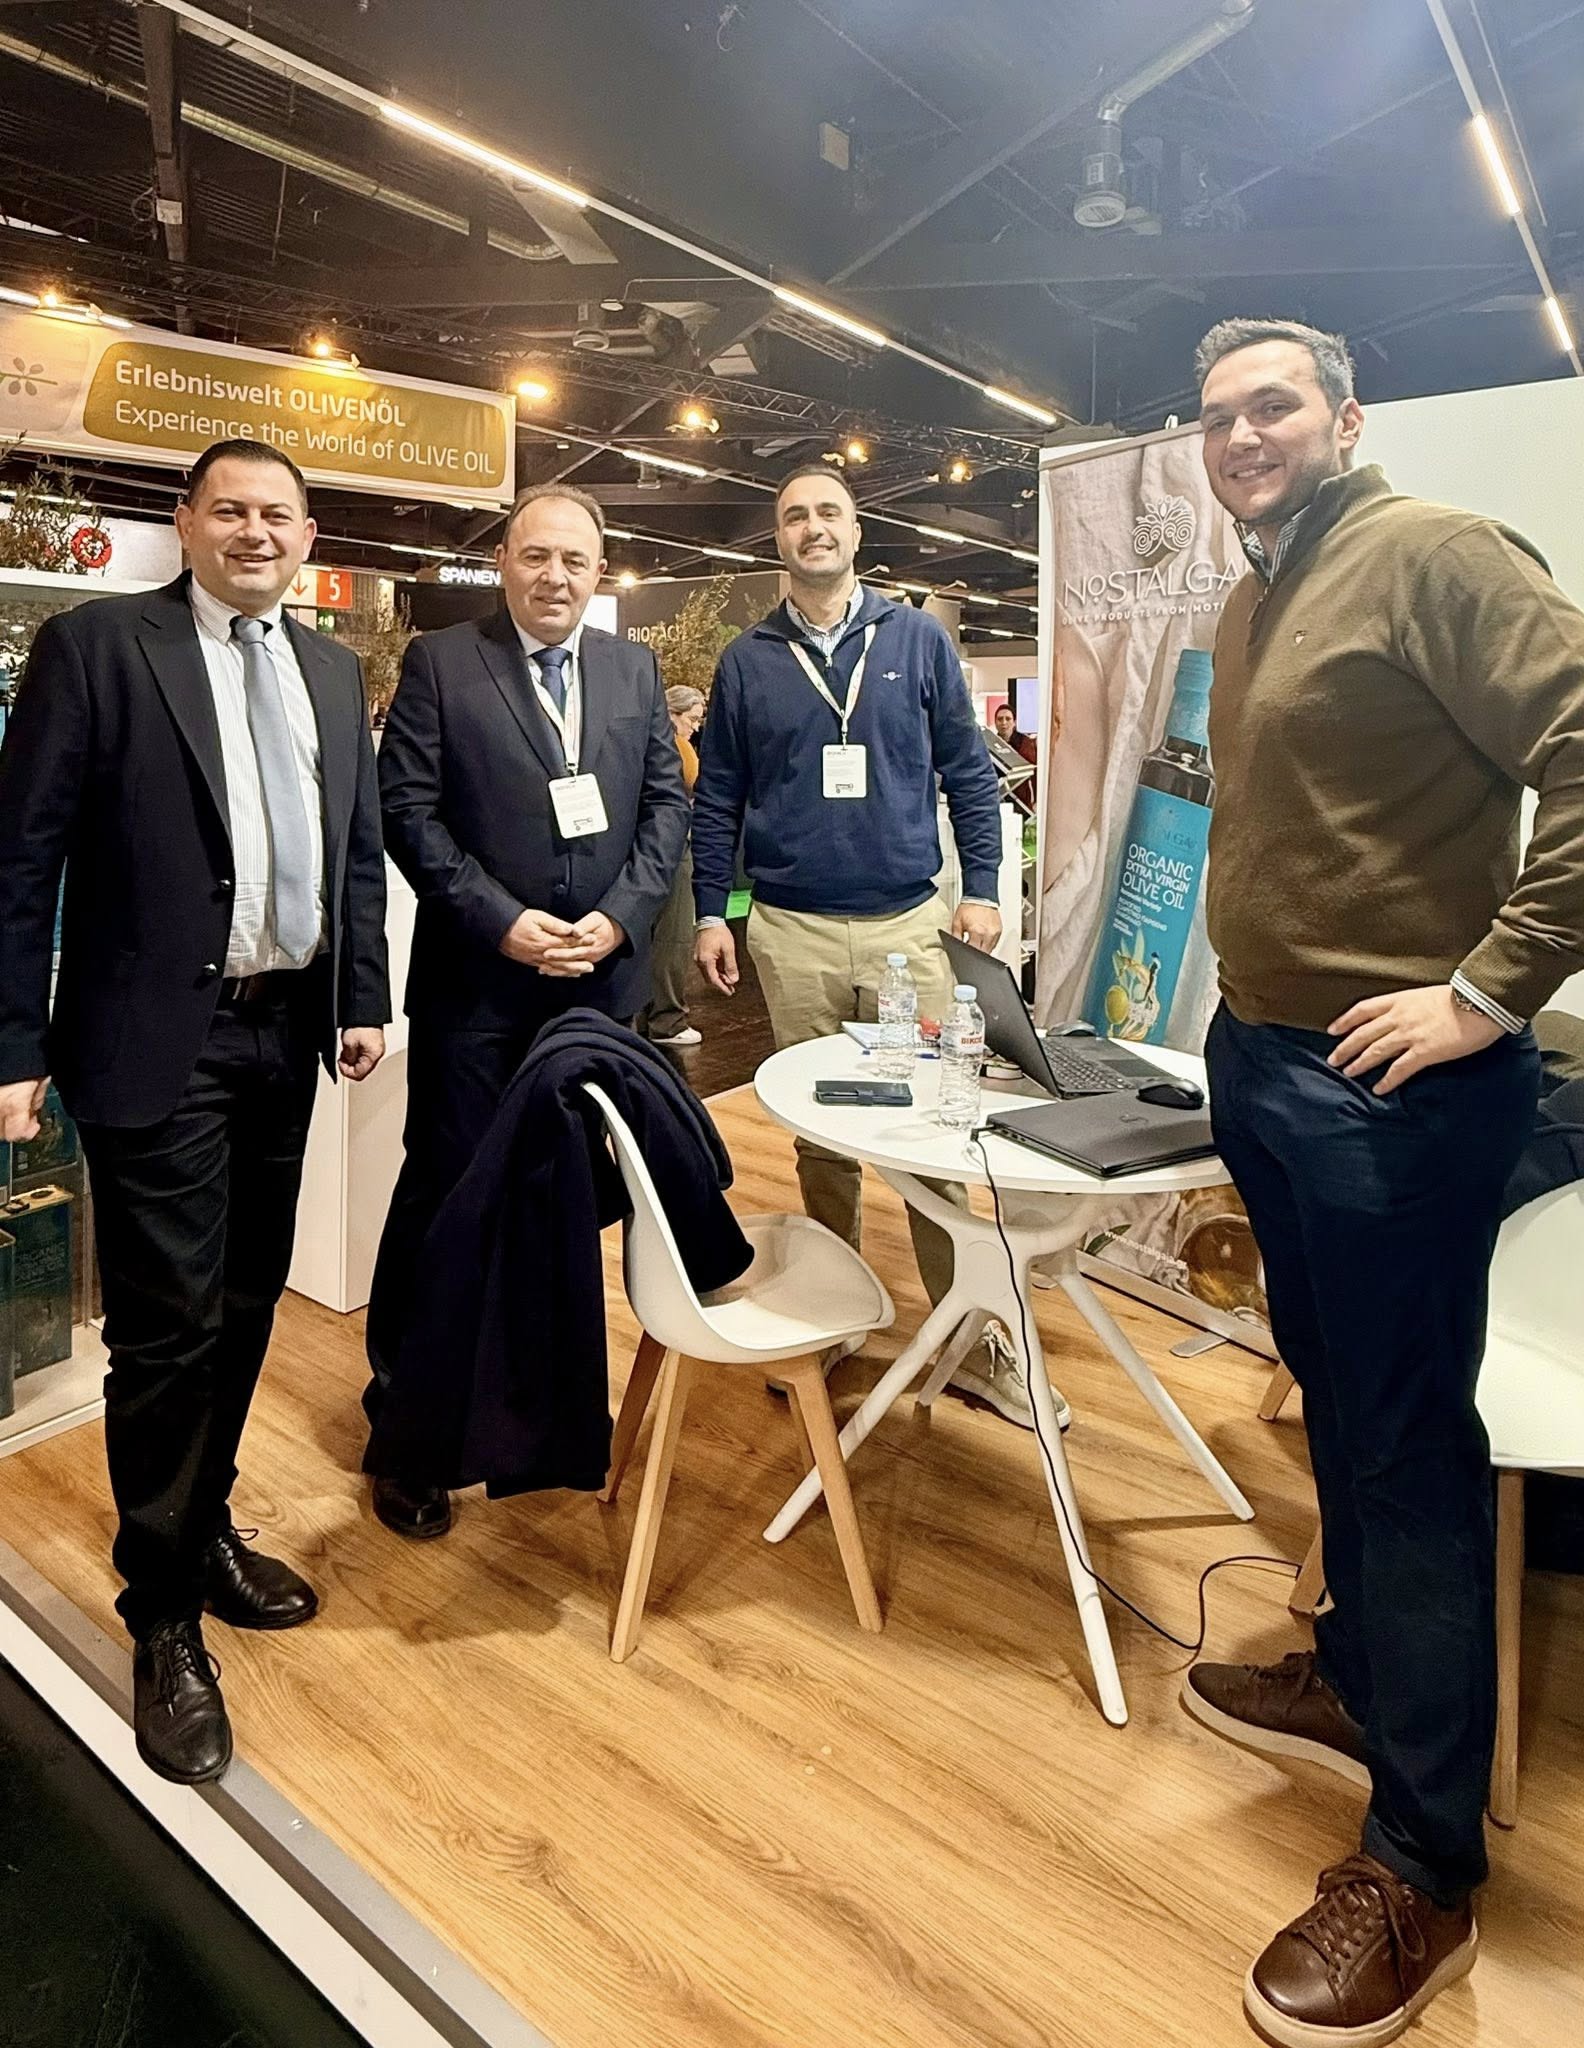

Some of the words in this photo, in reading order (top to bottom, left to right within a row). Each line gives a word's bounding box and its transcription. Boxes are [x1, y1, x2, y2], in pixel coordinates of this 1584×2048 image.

[115, 359, 283, 408] Erlebniswelt
[289, 389, 406, 427] OLIVENÖL
[115, 400, 253, 439] Experience
[259, 421, 299, 446] the
[305, 427, 366, 456] World
[372, 439, 394, 460] of
[400, 441, 458, 469] OLIVE
[463, 451, 495, 474] OIL
[328, 573, 341, 602] 5
[438, 566, 501, 586] SPANIEN
[1094, 609, 1150, 622] PRODUCTS
[1156, 605, 1186, 616] FROM
[1126, 859, 1153, 880] EXTRA
[1155, 871, 1190, 894] VIRGIN
[1128, 843, 1194, 881] ORGANIC
[1122, 872, 1160, 900] OLIVE
[1162, 889, 1185, 910] OIL
